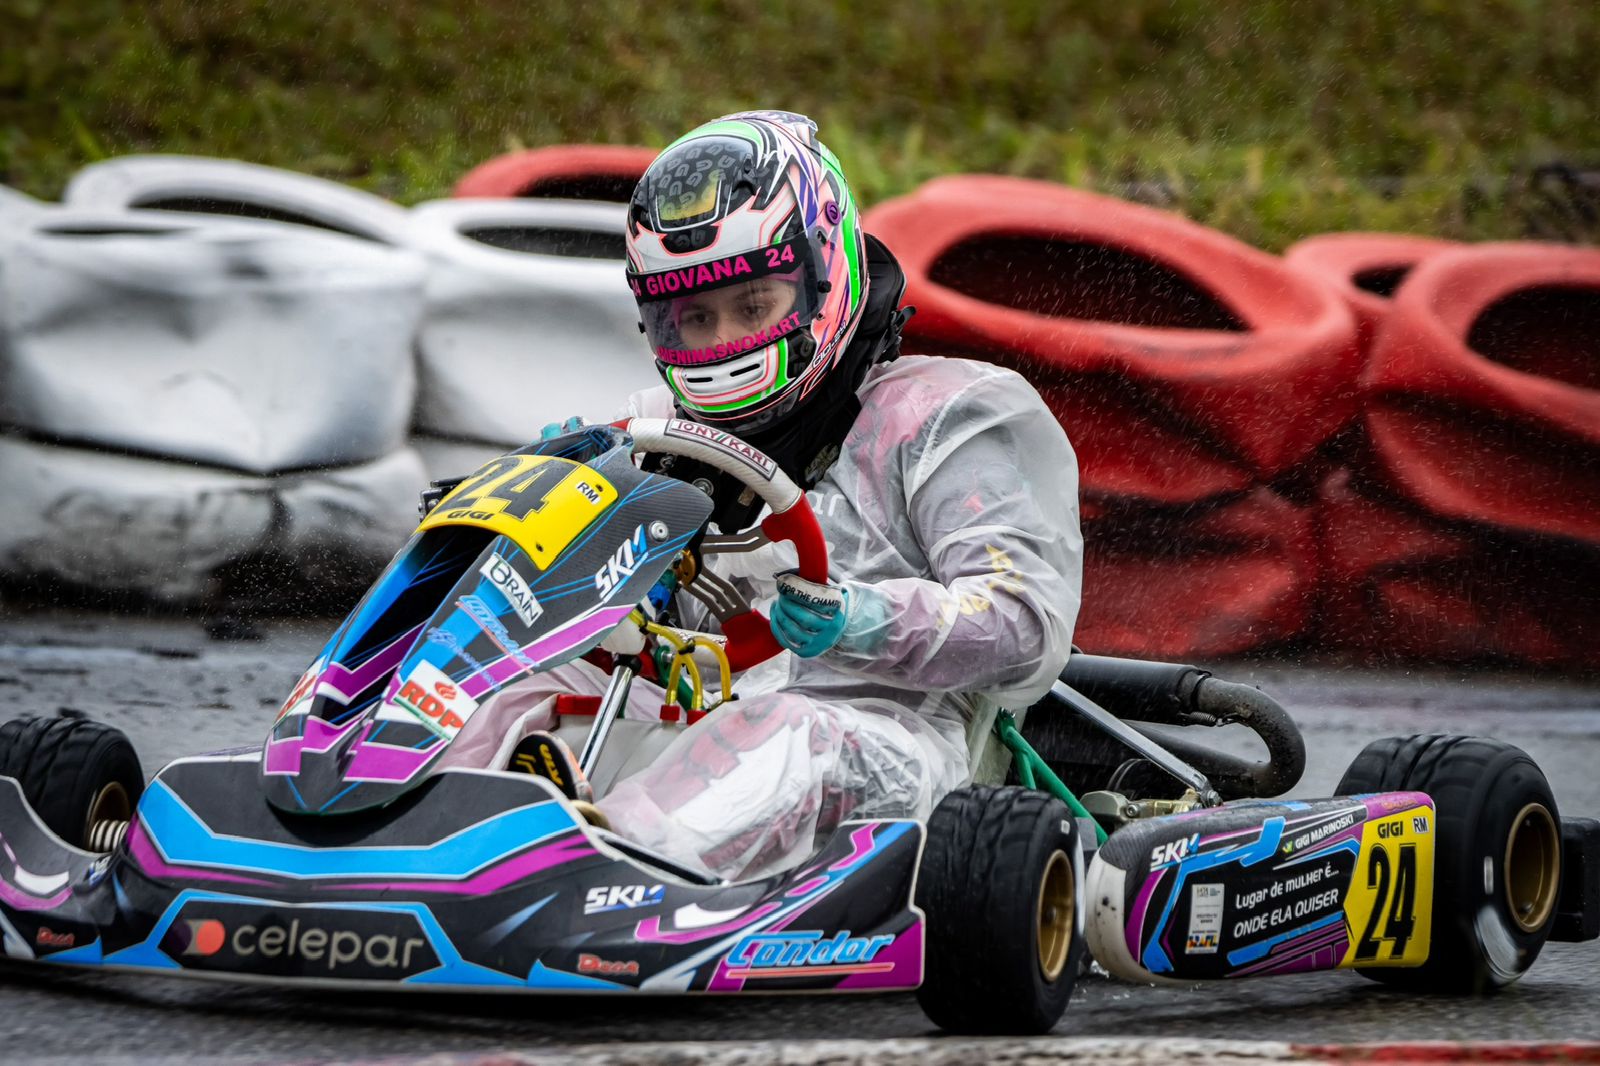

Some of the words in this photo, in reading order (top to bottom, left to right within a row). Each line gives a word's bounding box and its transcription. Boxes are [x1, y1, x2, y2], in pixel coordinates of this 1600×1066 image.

[646, 256, 752, 295] GIOVANA
[765, 244, 795, 268] 24
[431, 456, 581, 522] 24
[576, 481, 600, 504] RM
[447, 510, 495, 521] GIGI
[780, 582, 796, 595] FOR
[797, 589, 811, 600] THE
[398, 680, 464, 729] RDP
[1295, 833, 1310, 849] GIGI
[1310, 813, 1354, 843] MARINOSKI
[1377, 820, 1404, 839] GIGI
[1413, 817, 1427, 833] RM
[1233, 912, 1269, 938] ONDE
[1270, 905, 1293, 926] ELA
[1294, 888, 1339, 918] QUISER
[1235, 888, 1269, 910] Lugar
[1270, 881, 1283, 898] de
[1353, 842, 1416, 960] 24
[232, 918, 425, 971] celepar
[727, 930, 896, 967] Condor
